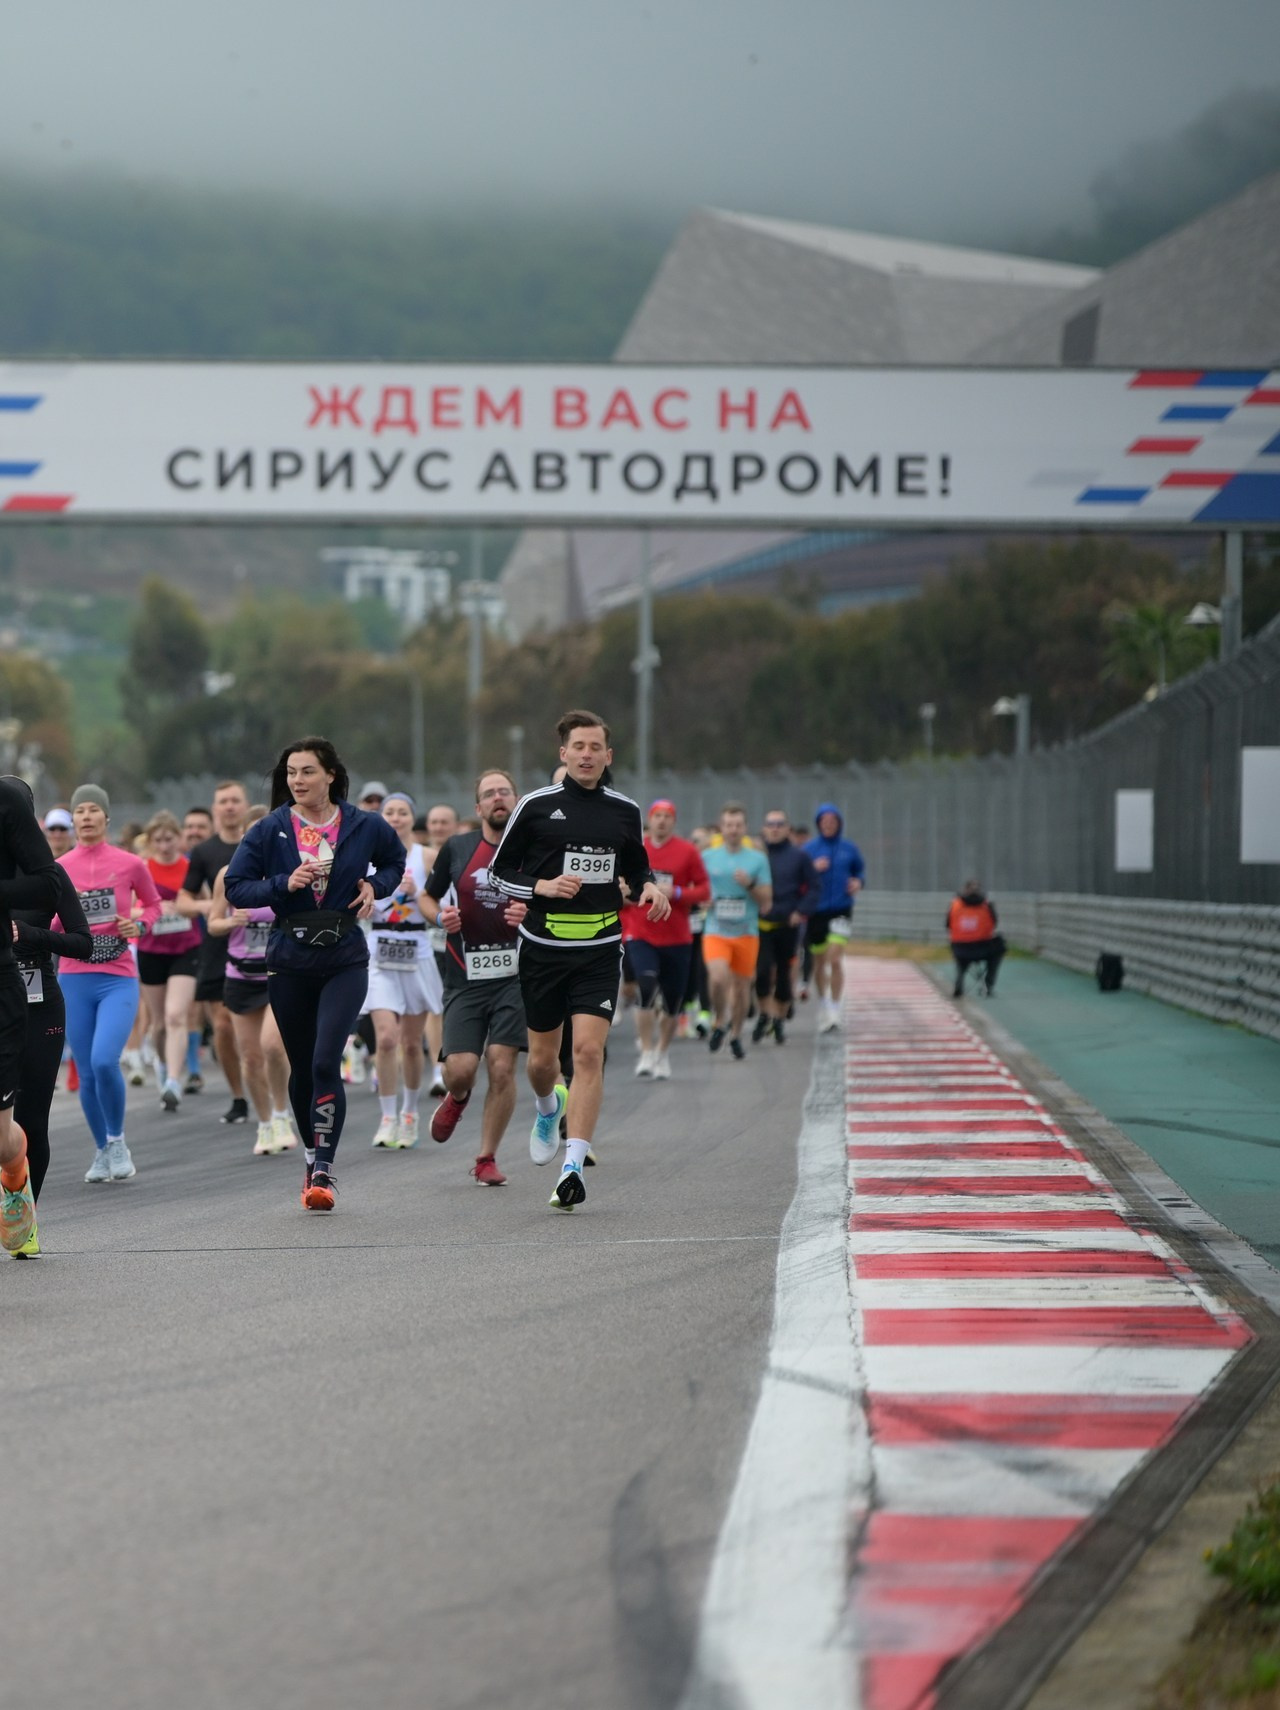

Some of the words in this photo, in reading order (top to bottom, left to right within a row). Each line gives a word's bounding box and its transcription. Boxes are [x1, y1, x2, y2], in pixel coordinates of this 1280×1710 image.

[308, 386, 524, 435] ЖДЕМ
[553, 387, 688, 430] ВАС
[718, 390, 811, 430] НА
[166, 449, 451, 491] СИРИУС
[478, 452, 952, 502] АВТОДРОМЕ!
[570, 857, 611, 873] 8396
[471, 954, 513, 969] 8268
[314, 1094, 336, 1148] FILA
